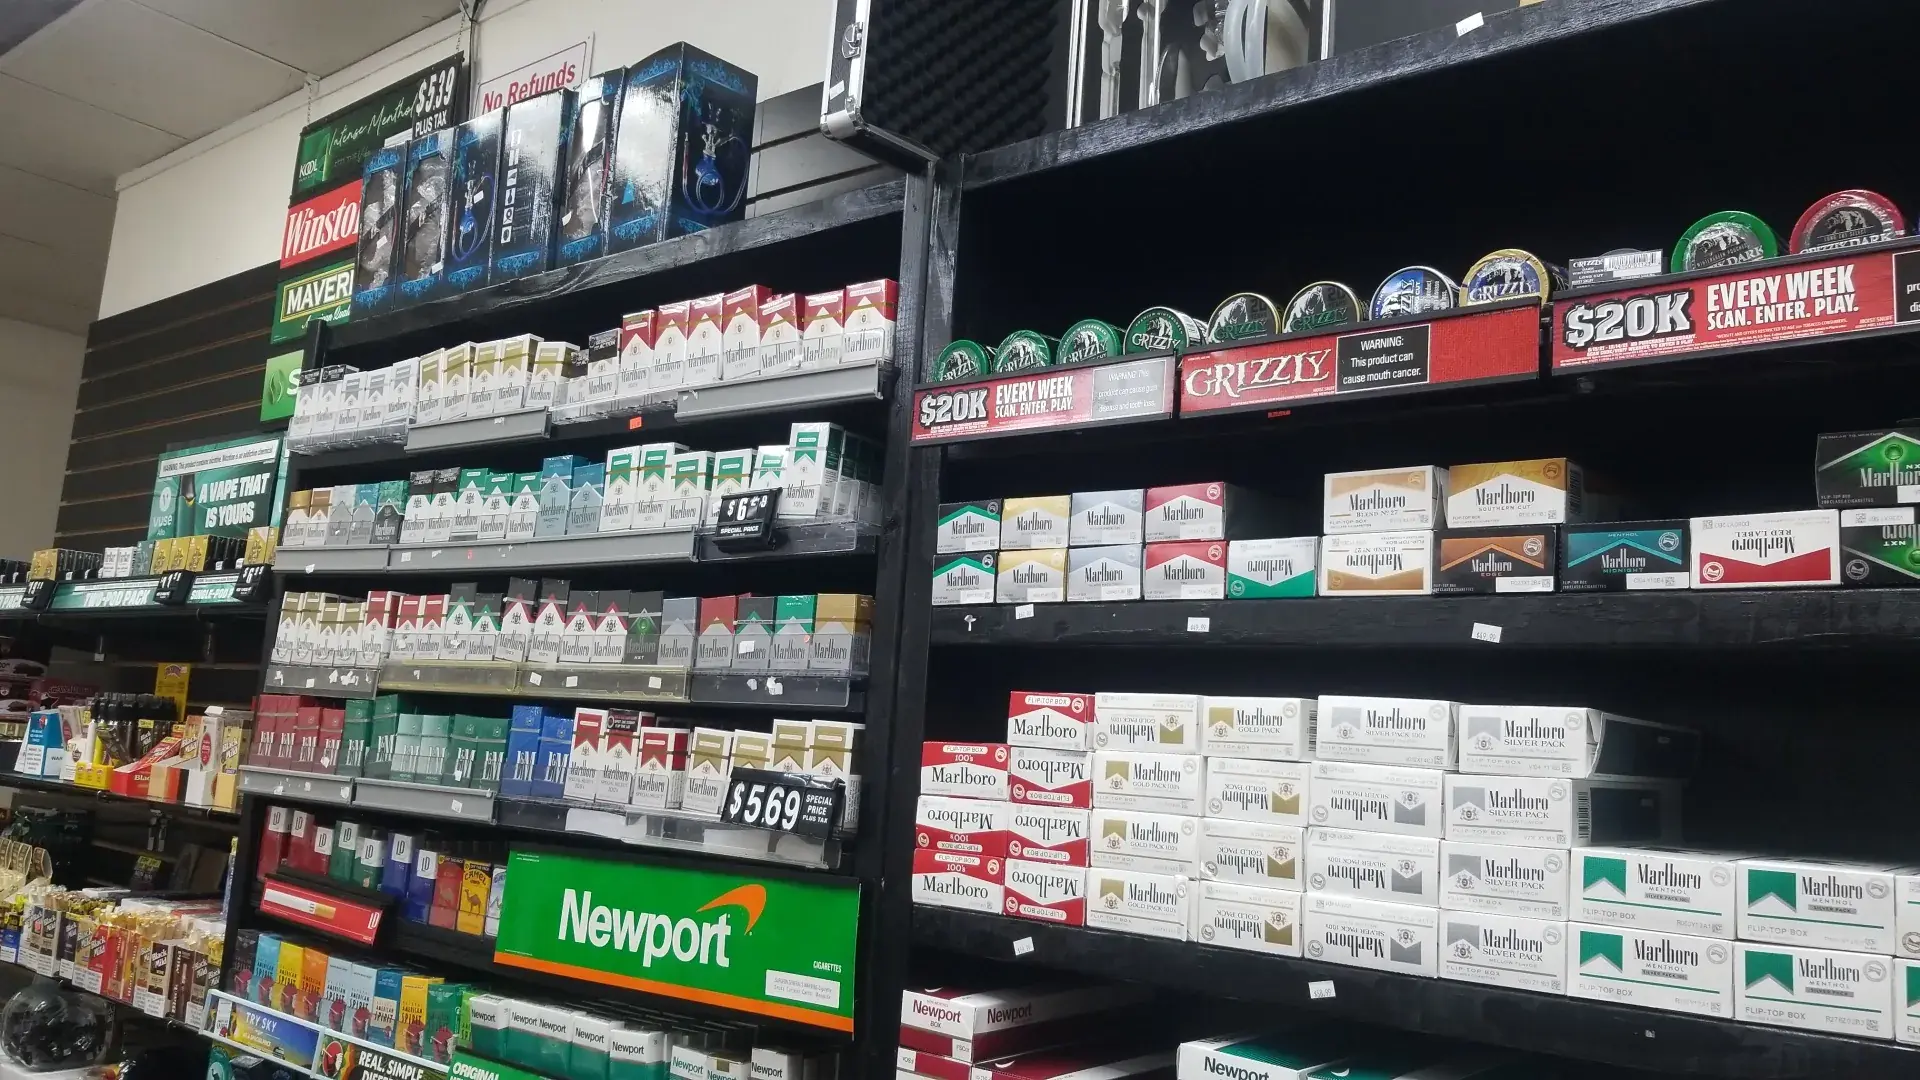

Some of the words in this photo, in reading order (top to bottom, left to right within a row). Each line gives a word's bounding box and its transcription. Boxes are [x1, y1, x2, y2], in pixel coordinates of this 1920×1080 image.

[482, 90, 503, 113] No
[508, 62, 576, 100] Refunds
[415, 118, 433, 137] PLUS
[433, 110, 448, 130] TAX
[299, 157, 318, 179] KOOL
[1729, 244, 1765, 267] DARK
[286, 269, 355, 315] MAVERI
[1469, 279, 1536, 302] GRIZZLY
[1707, 275, 1781, 312] EVERY
[1784, 263, 1855, 302] WEEK
[1290, 307, 1348, 332] GRIZZLY
[1565, 291, 1691, 348] $20K
[1707, 309, 1752, 331] SCAN.
[1755, 302, 1810, 325] ENTER.
[1815, 293, 1859, 317] PLAY.
[1132, 333, 1180, 350] GRIZZLY
[1360, 335, 1404, 351] WARNING:
[1351, 356, 1367, 369] This
[1367, 352, 1398, 368] product
[1398, 352, 1414, 362] can
[1184, 347, 1331, 398] GRIZZLY
[1342, 374, 1365, 385] cause
[1366, 370, 1391, 382] mouth
[1392, 367, 1422, 379] cancer.
[996, 380, 1035, 405] EVERY
[1037, 375, 1074, 399] WEEK
[919, 387, 988, 427] $20K
[995, 402, 1018, 418] SCAN.
[1020, 399, 1049, 416] ENTER.
[1051, 397, 1074, 412] PLAY.
[1860, 461, 1920, 488] Marlbor
[199, 487, 208, 503] A
[208, 480, 238, 502] VAPE
[238, 473, 270, 496] THAT
[1475, 483, 1535, 507] Marlboro
[1349, 489, 1406, 512] Marlboro
[1478, 504, 1515, 512] SOUTHERN
[205, 511, 219, 528] IS
[219, 501, 255, 527] YOURS
[1163, 500, 1204, 522] Marlboro
[743, 525, 760, 533] PRICE
[952, 516, 985, 535] Marlboro
[1016, 511, 1053, 532] Marlboro
[1770, 529, 1792, 537] RED
[1163, 560, 1205, 581] Marlboro
[813, 637, 848, 660] Marlboro
[1013, 714, 1078, 741] Marlboro
[1238, 726, 1256, 734] GOLD
[1504, 718, 1565, 740] Marlboro
[1504, 739, 1539, 748] SILVER
[1541, 740, 1566, 748] PACK
[638, 772, 665, 793] Marlboro
[931, 766, 997, 786] Marlboro
[689, 775, 719, 798] Marlboro
[805, 794, 833, 807] SPECIAL
[1488, 788, 1549, 811] Marlboro
[272, 812, 281, 826] LD
[802, 814, 815, 822] PLUS
[816, 815, 828, 824] TAX
[807, 804, 827, 816] PRICE
[1488, 809, 1522, 818] SILVER
[1524, 811, 1550, 819] PACK
[295, 815, 303, 831] LD
[319, 833, 328, 848] LD
[343, 827, 352, 842] LD
[365, 844, 374, 860] LD
[396, 840, 405, 856] LD
[422, 855, 431, 872] LD
[1485, 858, 1545, 882] Marlboro
[464, 870, 488, 886] CAMEL
[1484, 878, 1518, 888] SILVER
[1520, 881, 1545, 890] PACK
[1637, 863, 1701, 890] Marlboro
[922, 874, 989, 900] Marlboro
[1648, 887, 1688, 895] MENTHOL
[1802, 876, 1863, 900] Marlboro
[1127, 900, 1145, 909] GOLD
[1146, 902, 1162, 911] PACK
[1811, 898, 1853, 906] MENTHOL
[367, 911, 381, 930] LD
[1582, 908, 1616, 918] FLIP-TOP
[1618, 911, 1637, 920] BOX
[558, 887, 731, 968] Newport
[1747, 924, 1785, 935] FLIP-TOP
[1786, 929, 1808, 937] BOX
[1483, 928, 1543, 954] Marlboro
[1633, 938, 1699, 967] Marlboro
[813, 961, 842, 974] CIGARETTES
[1645, 963, 1685, 972] MENTHOL
[1799, 957, 1860, 983] Marlboro
[471, 1009, 496, 1022] Newport
[511, 1012, 538, 1027] Newport
[912, 998, 962, 1024] Newport
[987, 1002, 1032, 1025] Newport
[1745, 1006, 1784, 1018] FLIP-TOP
[1787, 1011, 1806, 1020] BOX
[246, 1012, 261, 1025] TRY
[261, 1017, 277, 1033] SKY
[539, 1018, 567, 1034] Newport
[930, 1020, 942, 1029] BOX
[575, 1027, 605, 1044] Newport
[612, 1041, 646, 1056] Newport
[387, 1059, 424, 1080] SIMPLE
[751, 1062, 783, 1078] Newport
